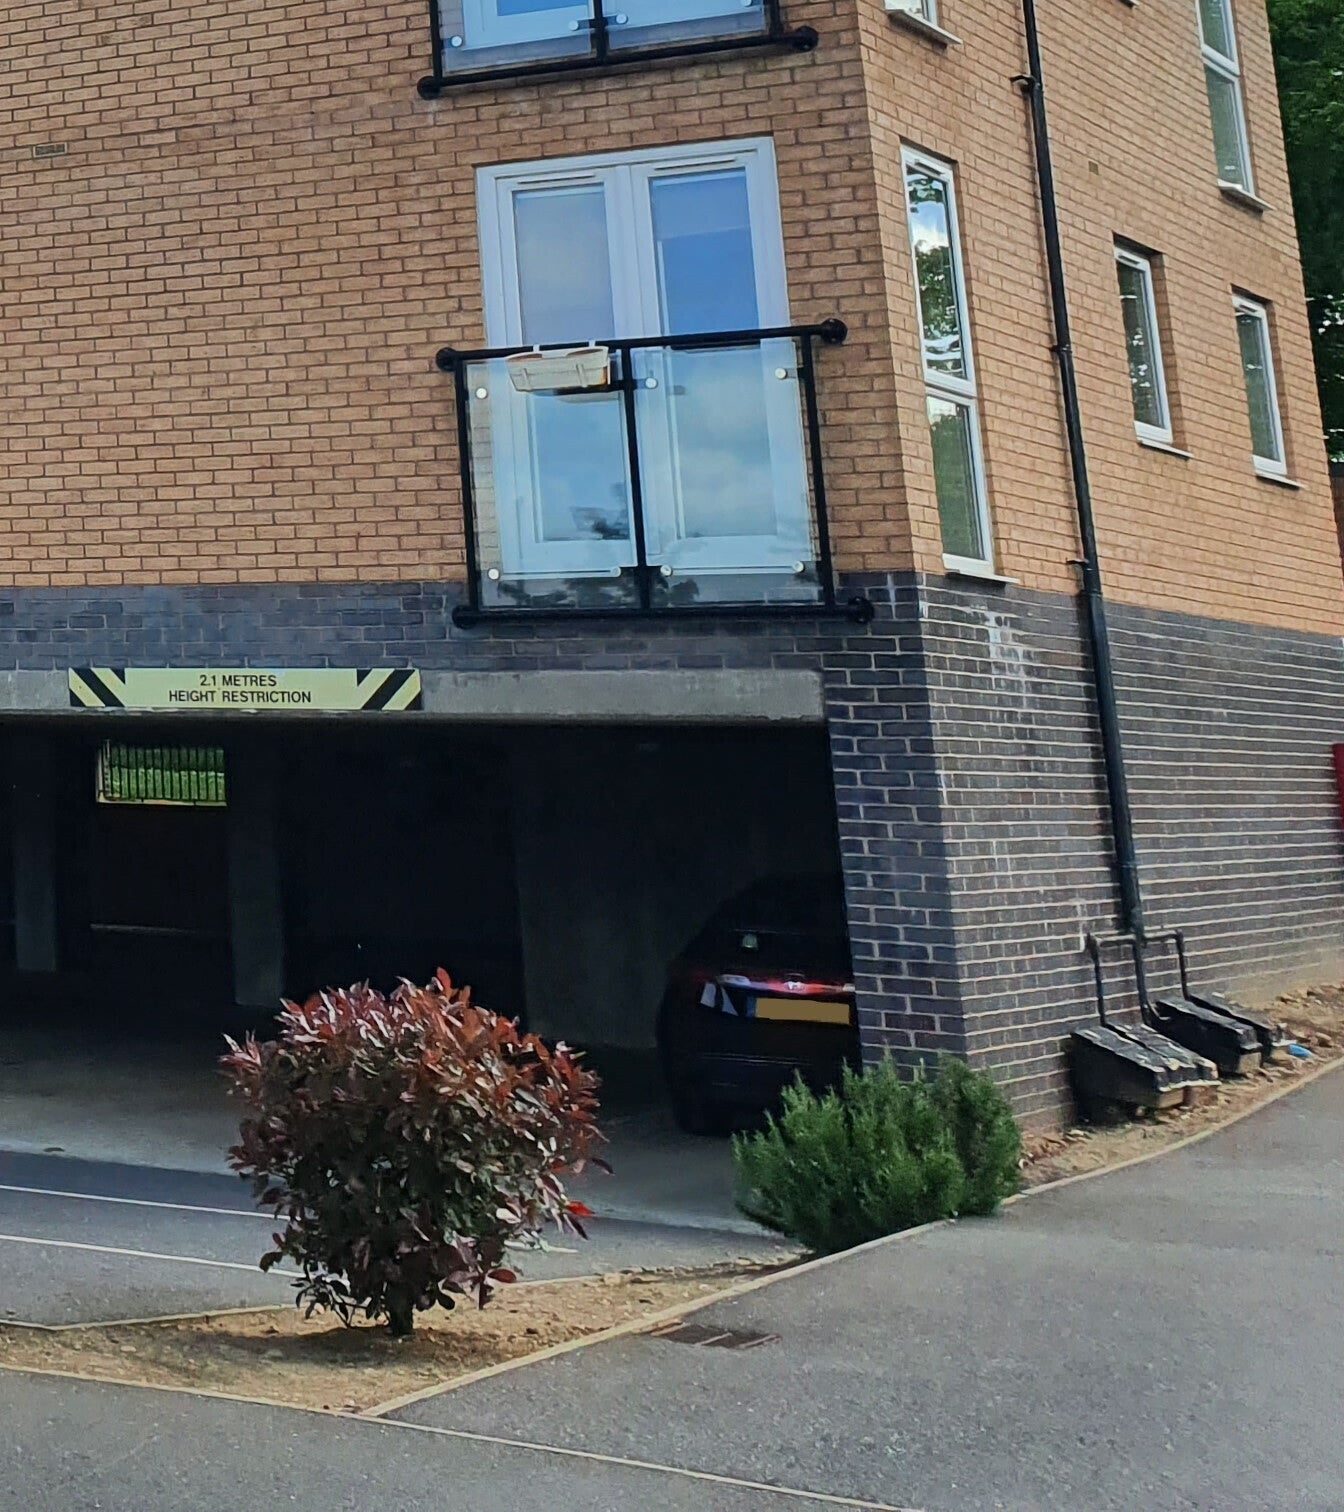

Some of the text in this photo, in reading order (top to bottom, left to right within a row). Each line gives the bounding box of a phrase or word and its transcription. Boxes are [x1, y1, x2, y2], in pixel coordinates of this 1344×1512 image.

[200, 675, 277, 687] 2.1 METRES
[169, 690, 311, 703] HEIGHT RESTRICTION
